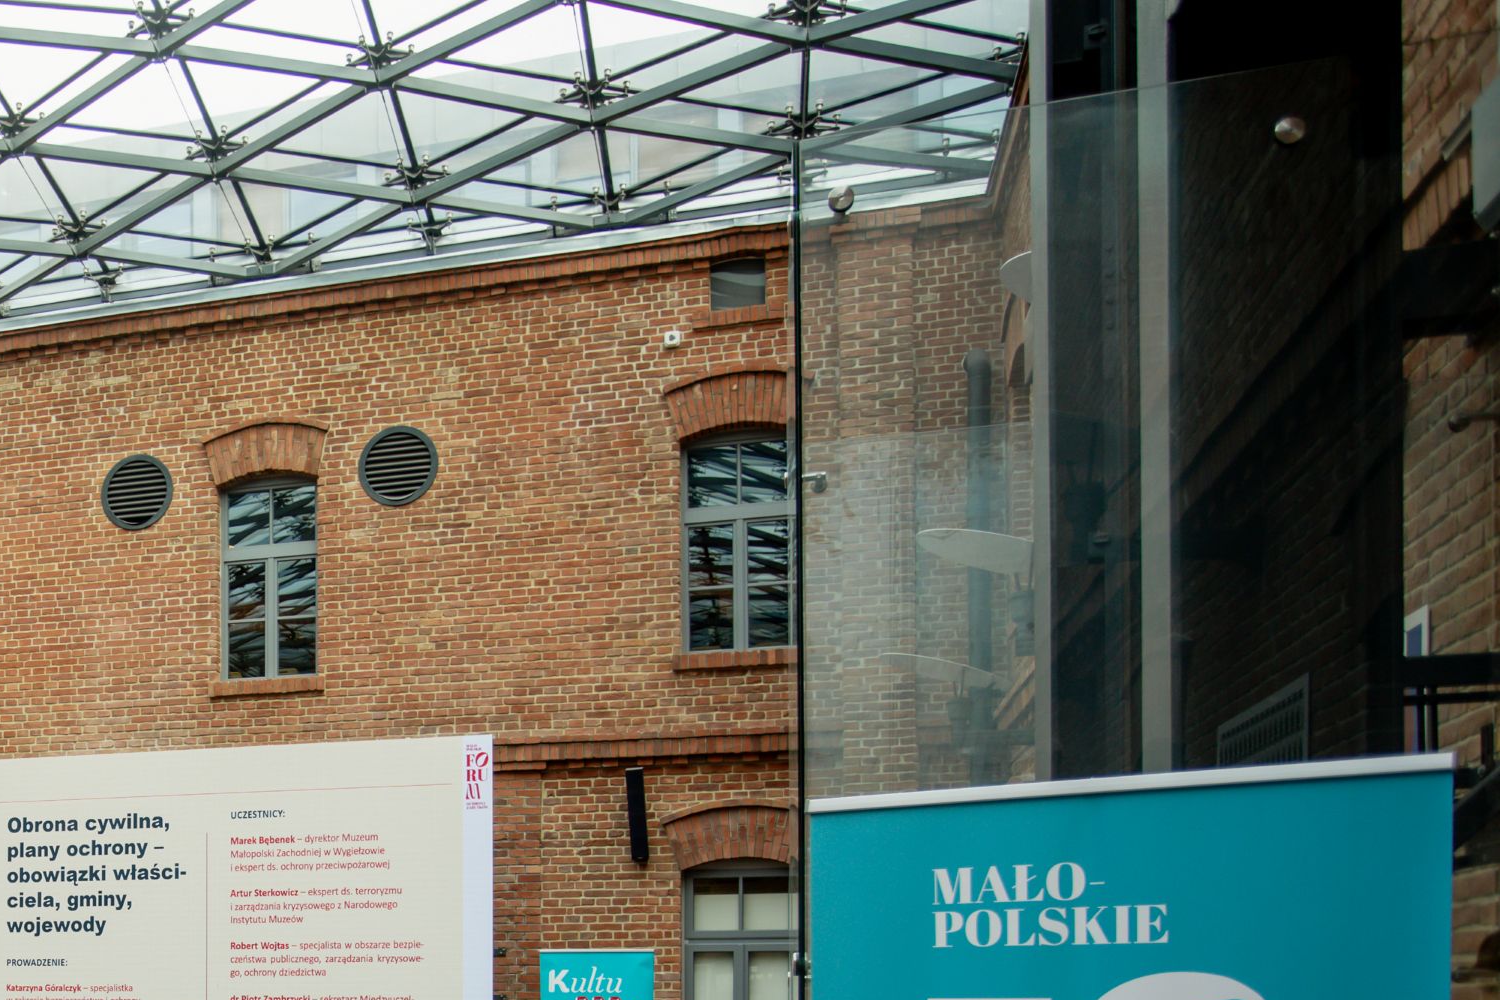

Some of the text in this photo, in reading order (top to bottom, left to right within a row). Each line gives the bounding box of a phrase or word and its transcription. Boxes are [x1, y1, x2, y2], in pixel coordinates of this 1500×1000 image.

[230, 809, 286, 820] UCZESTNICY:
[7, 812, 170, 835] Obrona cywilna,
[230, 836, 257, 845] Marek
[258, 835, 295, 846] Bębenek
[304, 834, 340, 846] dyrektor
[341, 833, 379, 843] Muzeum
[7, 842, 60, 862] plany
[66, 840, 148, 859] ochrony
[230, 849, 275, 860] Małopolski
[276, 847, 322, 859] Zachodniej
[323, 849, 331, 857] w
[234, 863, 265, 873] ekspert
[266, 862, 278, 872] ds.
[280, 861, 314, 872] ochrony
[315, 860, 391, 871] przeciwpożarowej
[7, 863, 187, 886] obowiązki właści-
[931, 861, 1106, 906] MAŁO-
[230, 888, 252, 898] Artur
[253, 887, 299, 898] Sterkowicz
[307, 887, 339, 898] ekspert
[340, 887, 353, 897] ds.
[355, 887, 403, 897] terroryzmu
[6, 891, 132, 912] ciela, gminy,
[234, 901, 281, 912] zarządzania
[282, 900, 336, 911] kryzysowego
[343, 899, 398, 910] Narodowego
[230, 914, 304, 925] Instytutu Muzeów
[931, 903, 1170, 949] POLSKIE
[6, 916, 107, 937] wojewody
[230, 941, 259, 950] Robert
[260, 941, 290, 952] Wojtas
[299, 940, 342, 951] specjalista
[344, 942, 353, 950] w
[354, 940, 391, 950] obszarze
[393, 940, 424, 950] bezpie-
[6, 958, 69, 967] PROWADZENIE:
[230, 954, 424, 965] czeństwa publicznego, zarządzania kryzysowe-
[229, 967, 327, 978] go, ochrony dziedzictwa
[548, 965, 623, 994] Kultu
[6, 983, 43, 993] Katarzyna
[44, 982, 82, 993] Góralczyk
[89, 982, 134, 993] specjalistka
